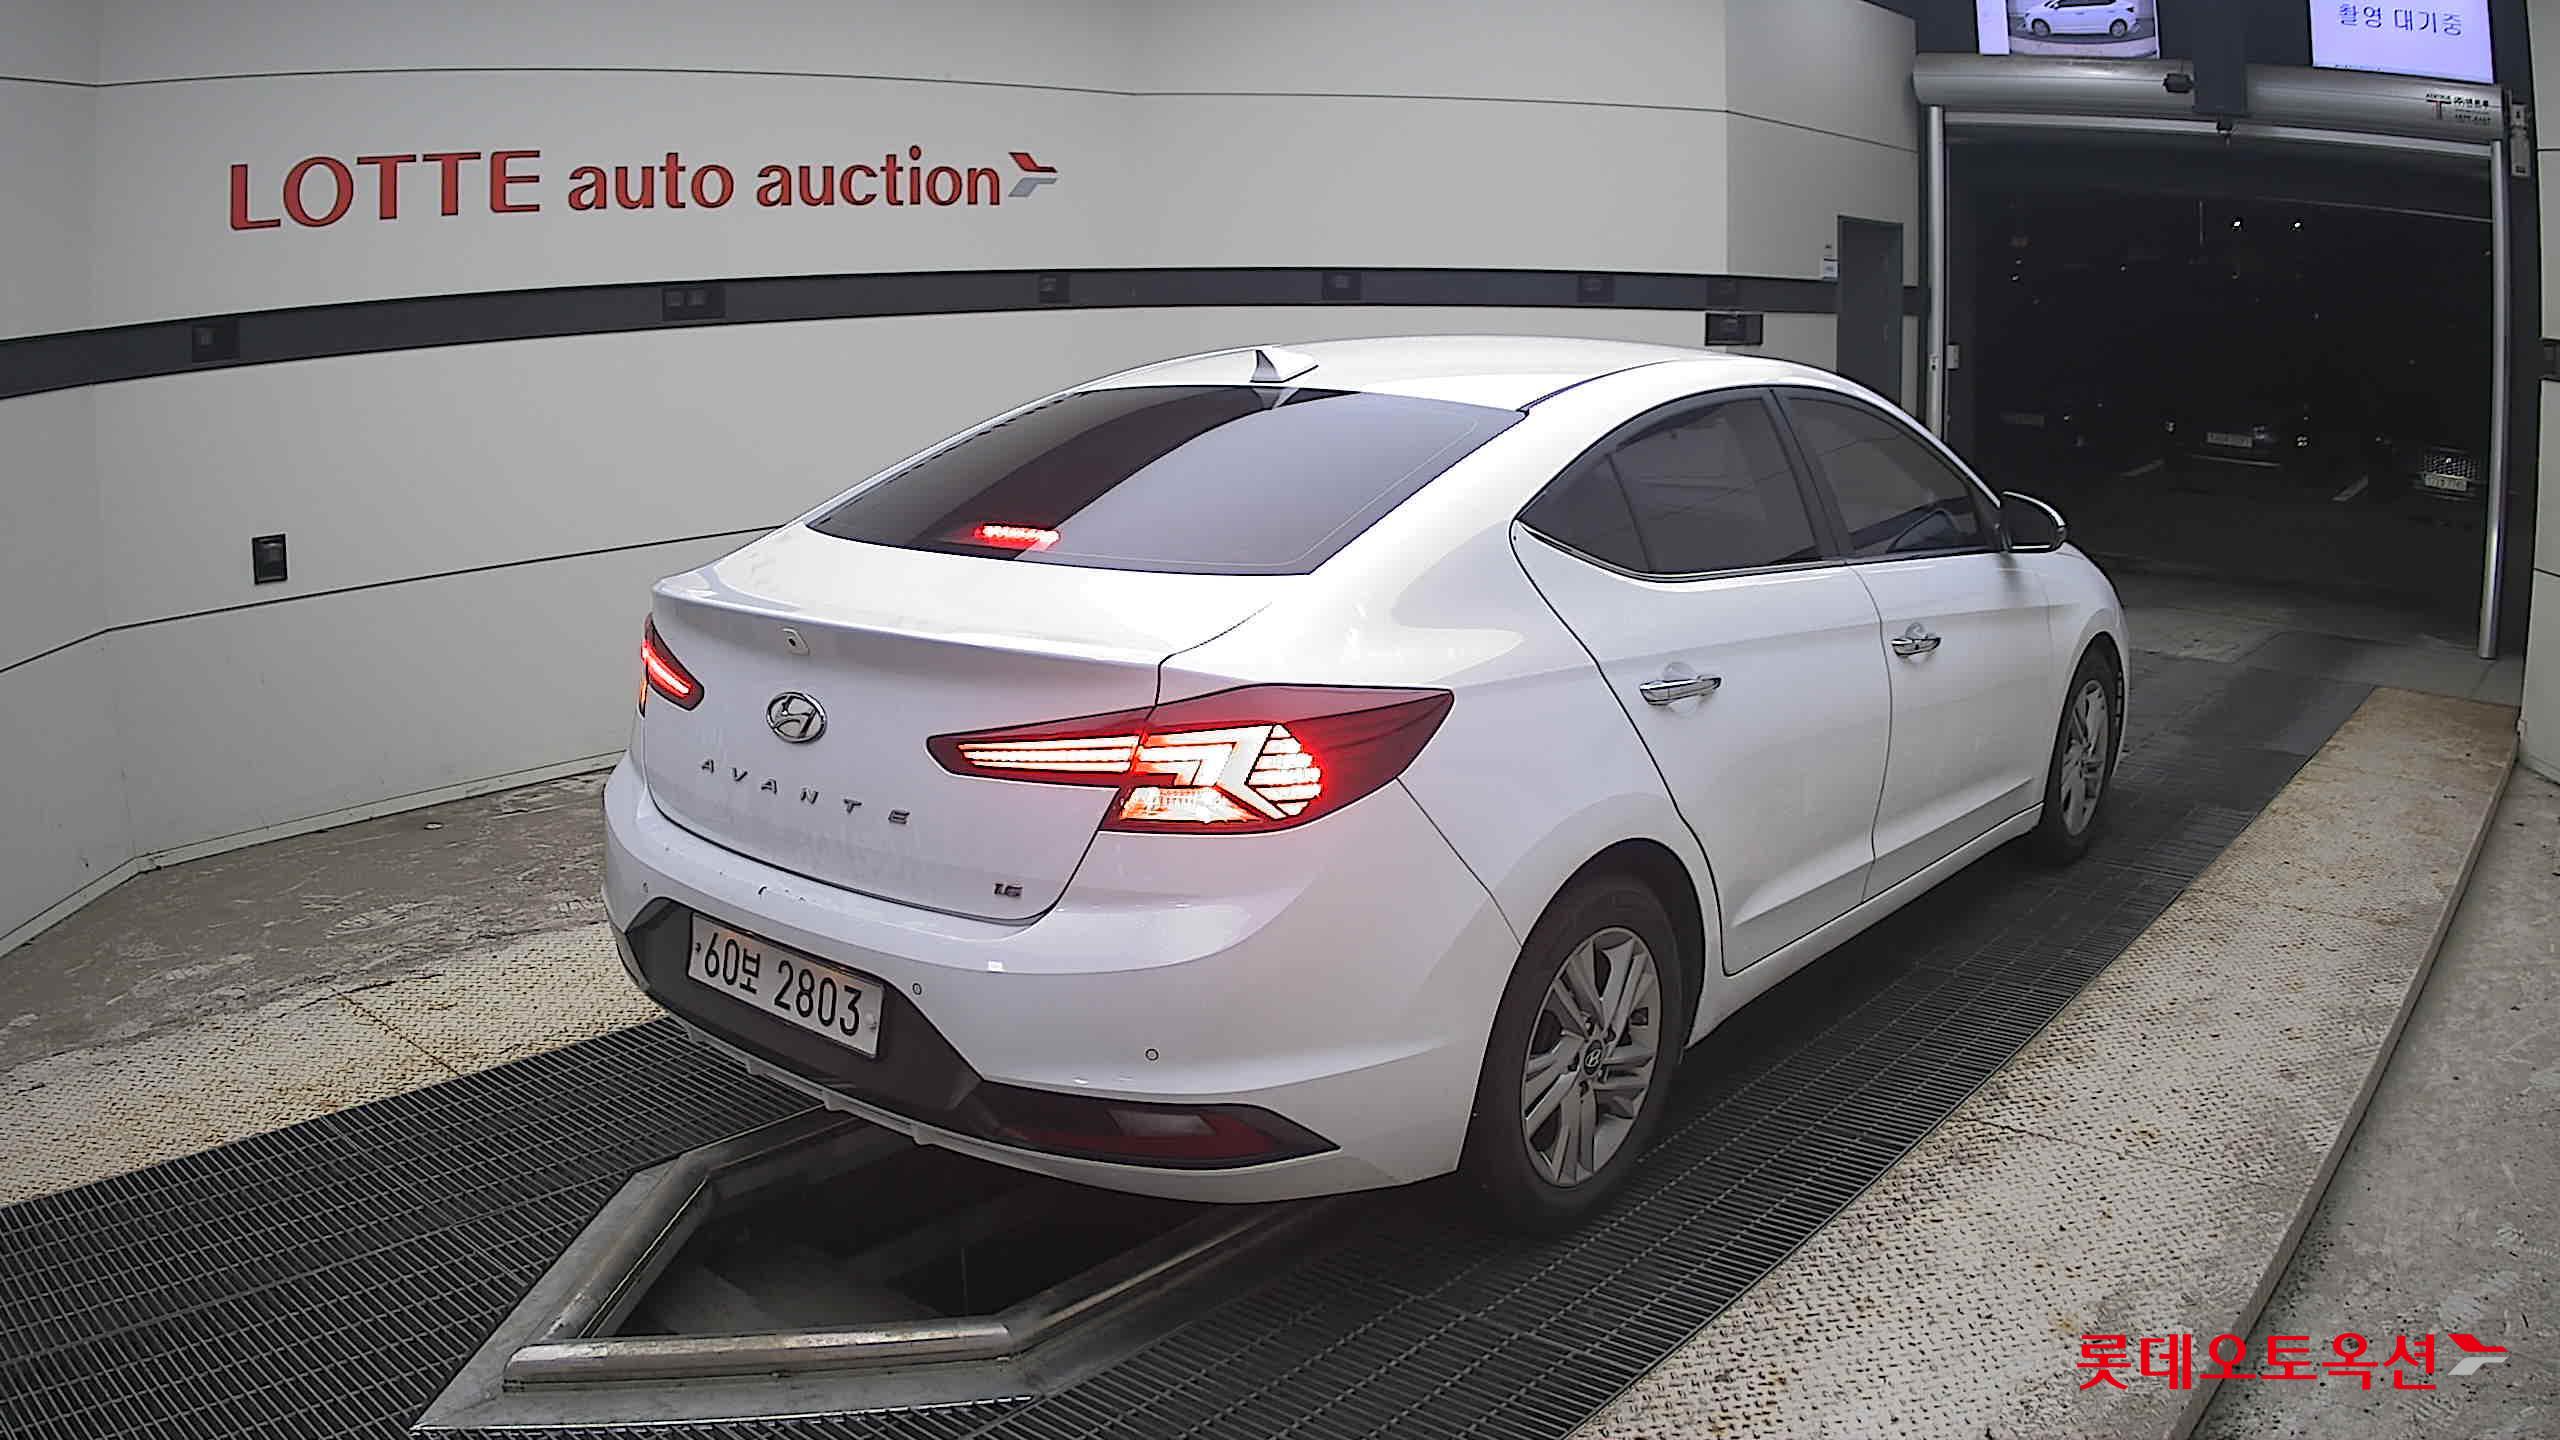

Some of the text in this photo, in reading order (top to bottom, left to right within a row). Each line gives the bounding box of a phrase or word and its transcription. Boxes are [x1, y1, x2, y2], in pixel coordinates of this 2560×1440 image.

[2339, 3, 2463, 37] 촬영 대기중
[230, 146, 1001, 231] LOTTE auto auction
[701, 759, 910, 825] AVANTE
[704, 932, 863, 1037] 60보 2803
